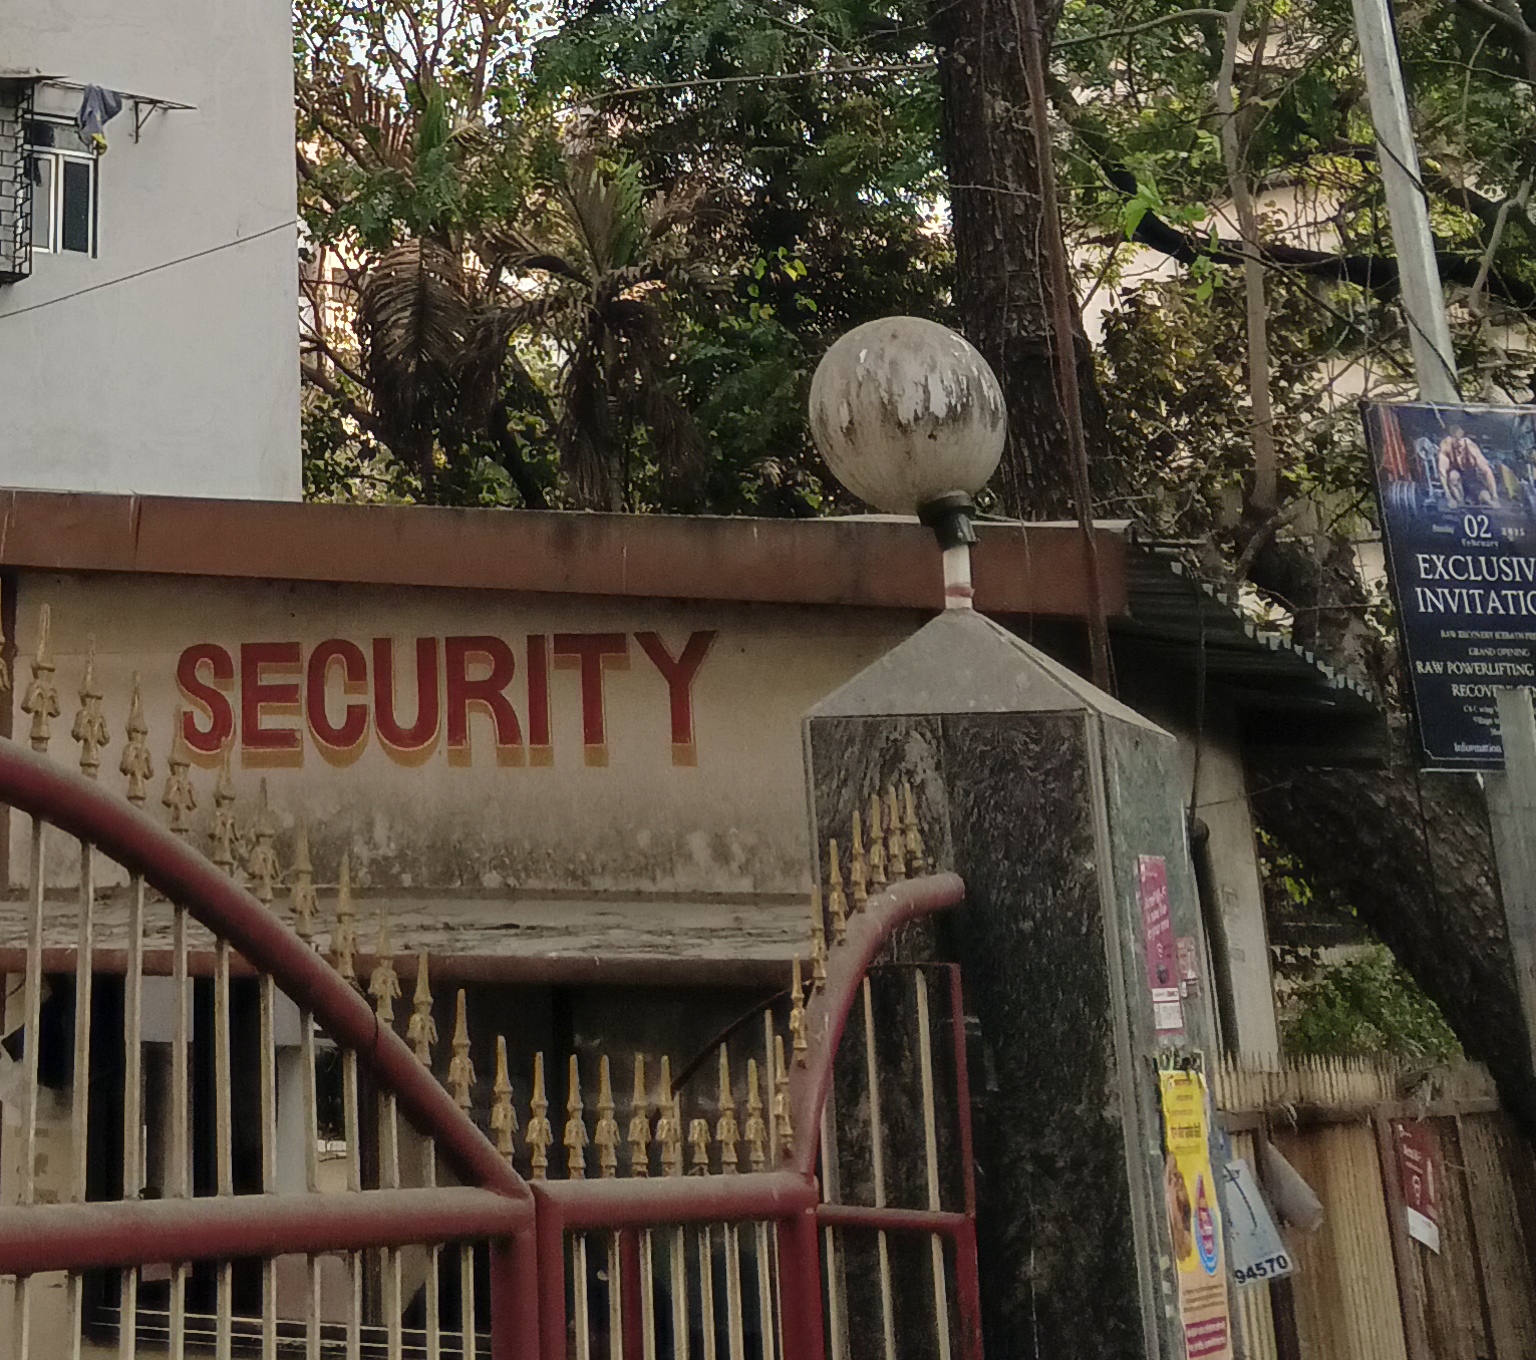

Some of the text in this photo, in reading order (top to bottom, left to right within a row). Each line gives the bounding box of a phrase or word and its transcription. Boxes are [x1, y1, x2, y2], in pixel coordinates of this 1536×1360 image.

[1464, 514, 1492, 538] 02
[1415, 660, 1535, 677] RAW POWERLIFTING
[175, 630, 718, 769] SECURITY
[1234, 1254, 1289, 1284] 94570
